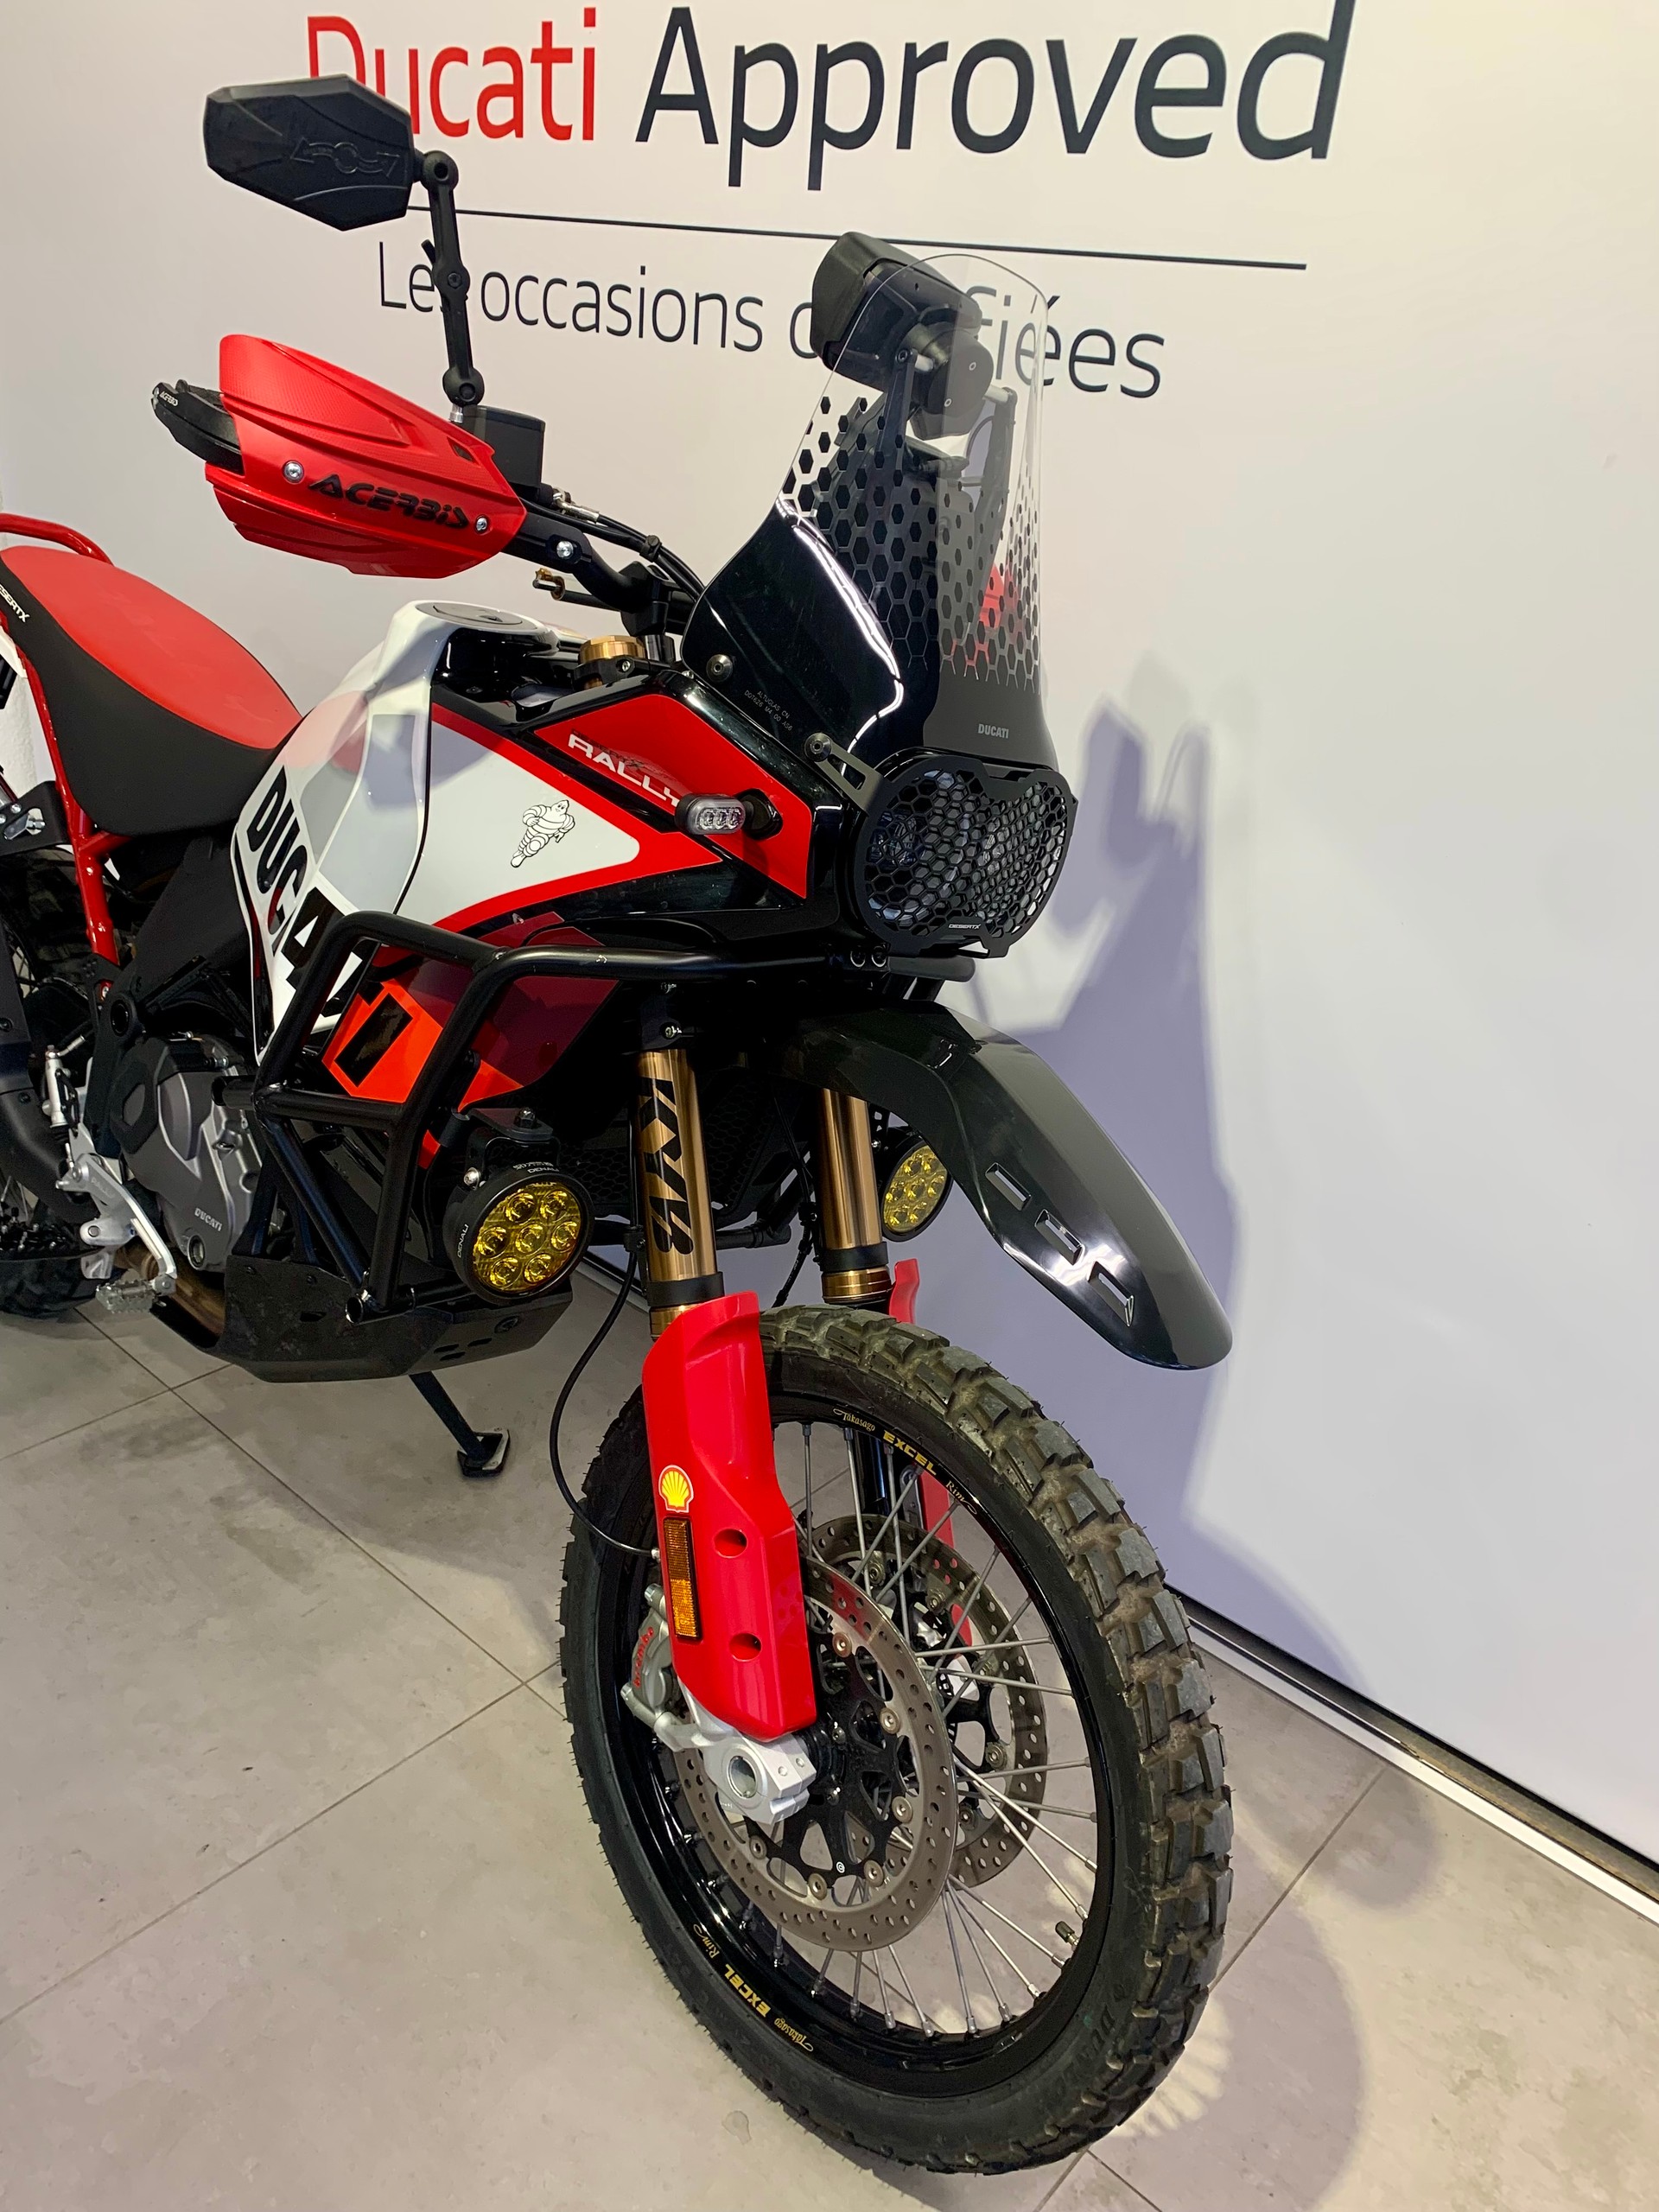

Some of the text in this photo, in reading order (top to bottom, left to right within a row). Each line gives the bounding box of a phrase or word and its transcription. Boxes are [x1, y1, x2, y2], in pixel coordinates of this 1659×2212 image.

[308, 0, 1356, 191] Ducati Approved
[379, 241, 444, 313] Le
[480, 265, 763, 353] occasions
[568, 734, 680, 808] RALLY
[977, 723, 1009, 739] DUCATI
[194, 1207, 223, 1231] DUCATI
[457, 1224, 469, 1258] DENALI
[833, 1408, 976, 1513] Takasago EXCEL Rim
[695, 1925, 814, 2052] Takasago EXCEL Rim
